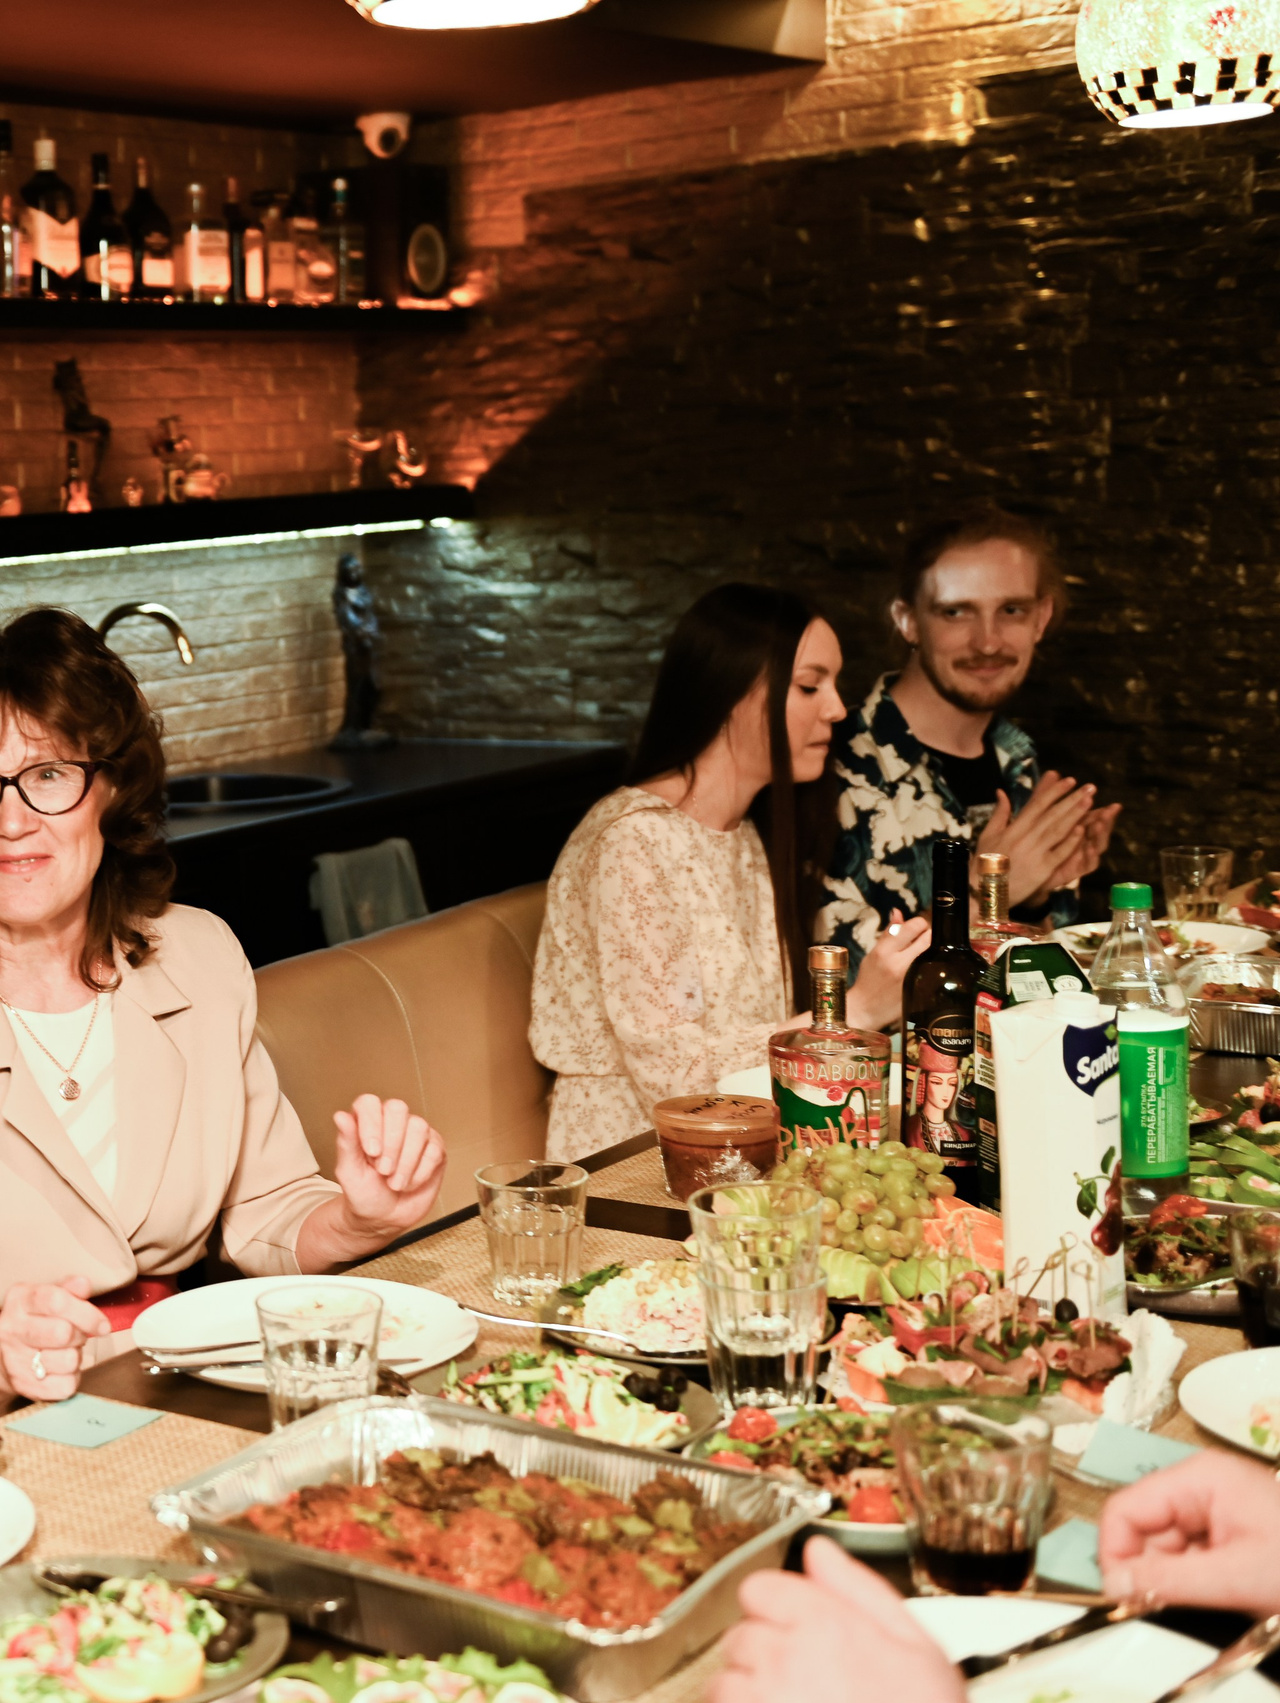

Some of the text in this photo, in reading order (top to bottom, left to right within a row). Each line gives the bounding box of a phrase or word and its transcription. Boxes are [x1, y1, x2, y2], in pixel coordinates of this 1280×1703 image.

[805, 1062, 879, 1082] BABOON
[1076, 1044, 1119, 1085] Santa
[1147, 1046, 1157, 1164] ПЕРЕРАБАТЫВАЕМАЯ
